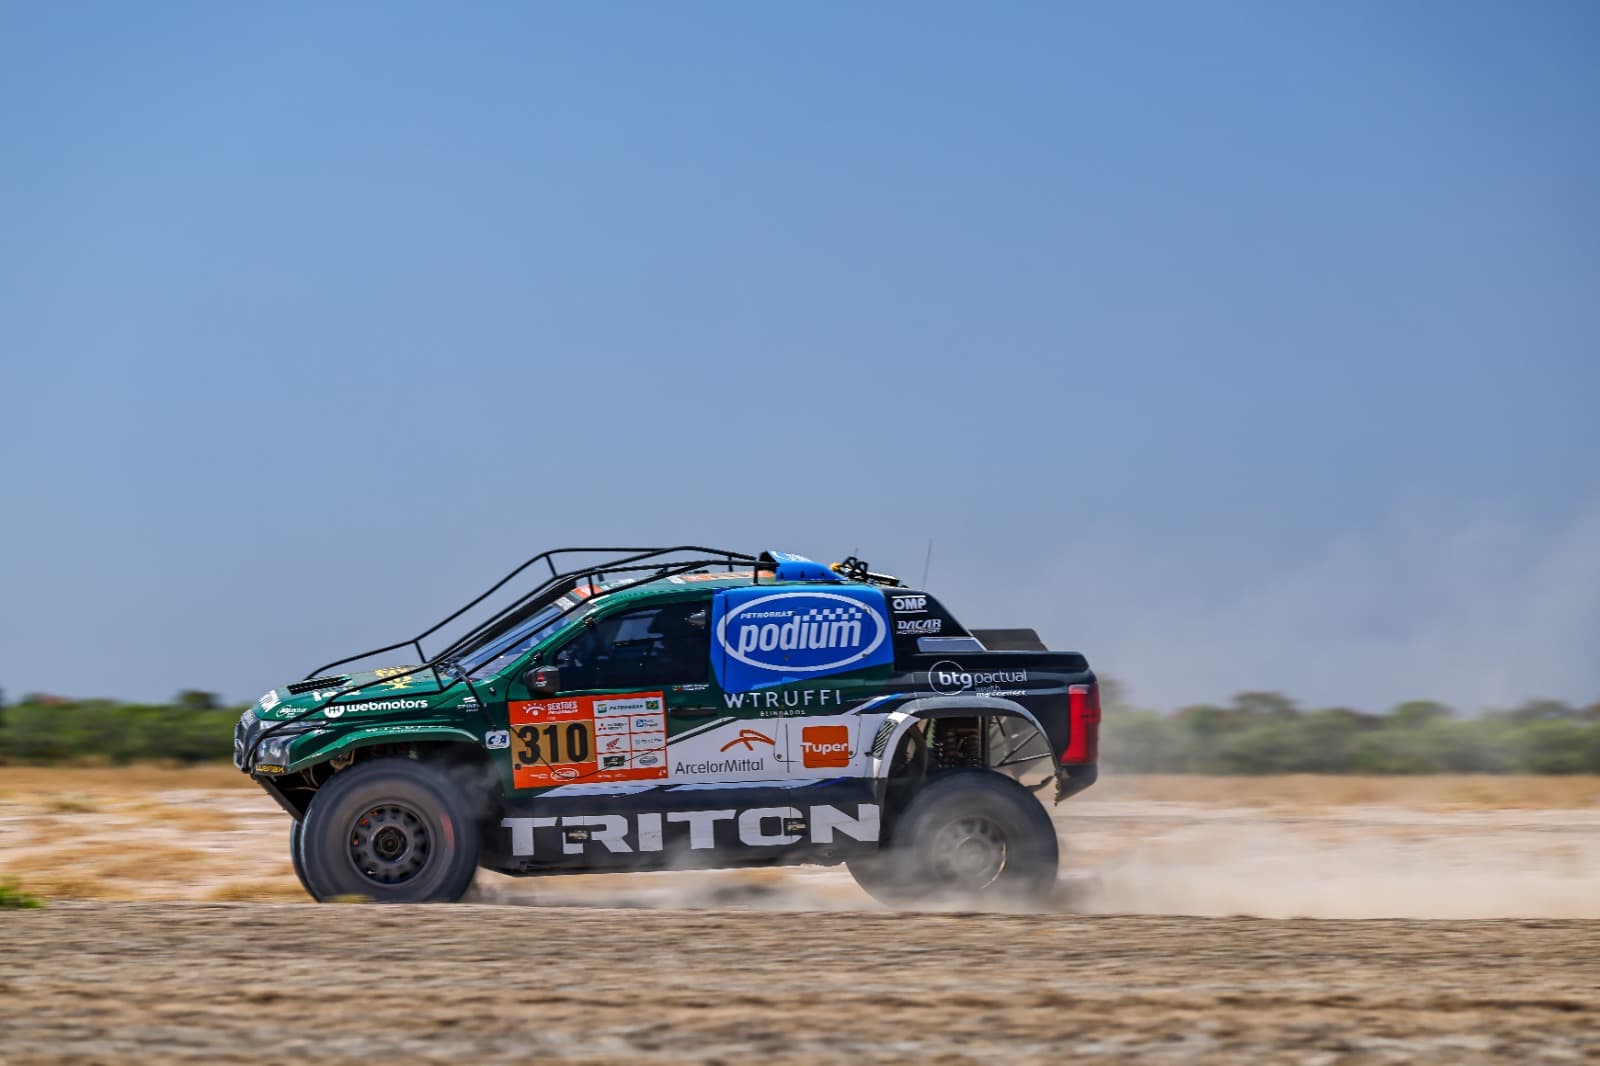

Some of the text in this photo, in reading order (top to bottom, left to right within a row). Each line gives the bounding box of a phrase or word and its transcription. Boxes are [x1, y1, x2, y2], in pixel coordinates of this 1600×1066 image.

[892, 597, 927, 610] OMP
[740, 611, 796, 619] PETROBRAS
[738, 616, 862, 657] podium
[939, 668, 1027, 688] btg pactual
[346, 699, 429, 713] webmotors
[760, 709, 806, 717] BLINDADOS
[519, 723, 588, 764] 310
[802, 741, 848, 756] Tuper
[674, 757, 764, 775] ArcelorMittal
[501, 804, 880, 856] TRITON
